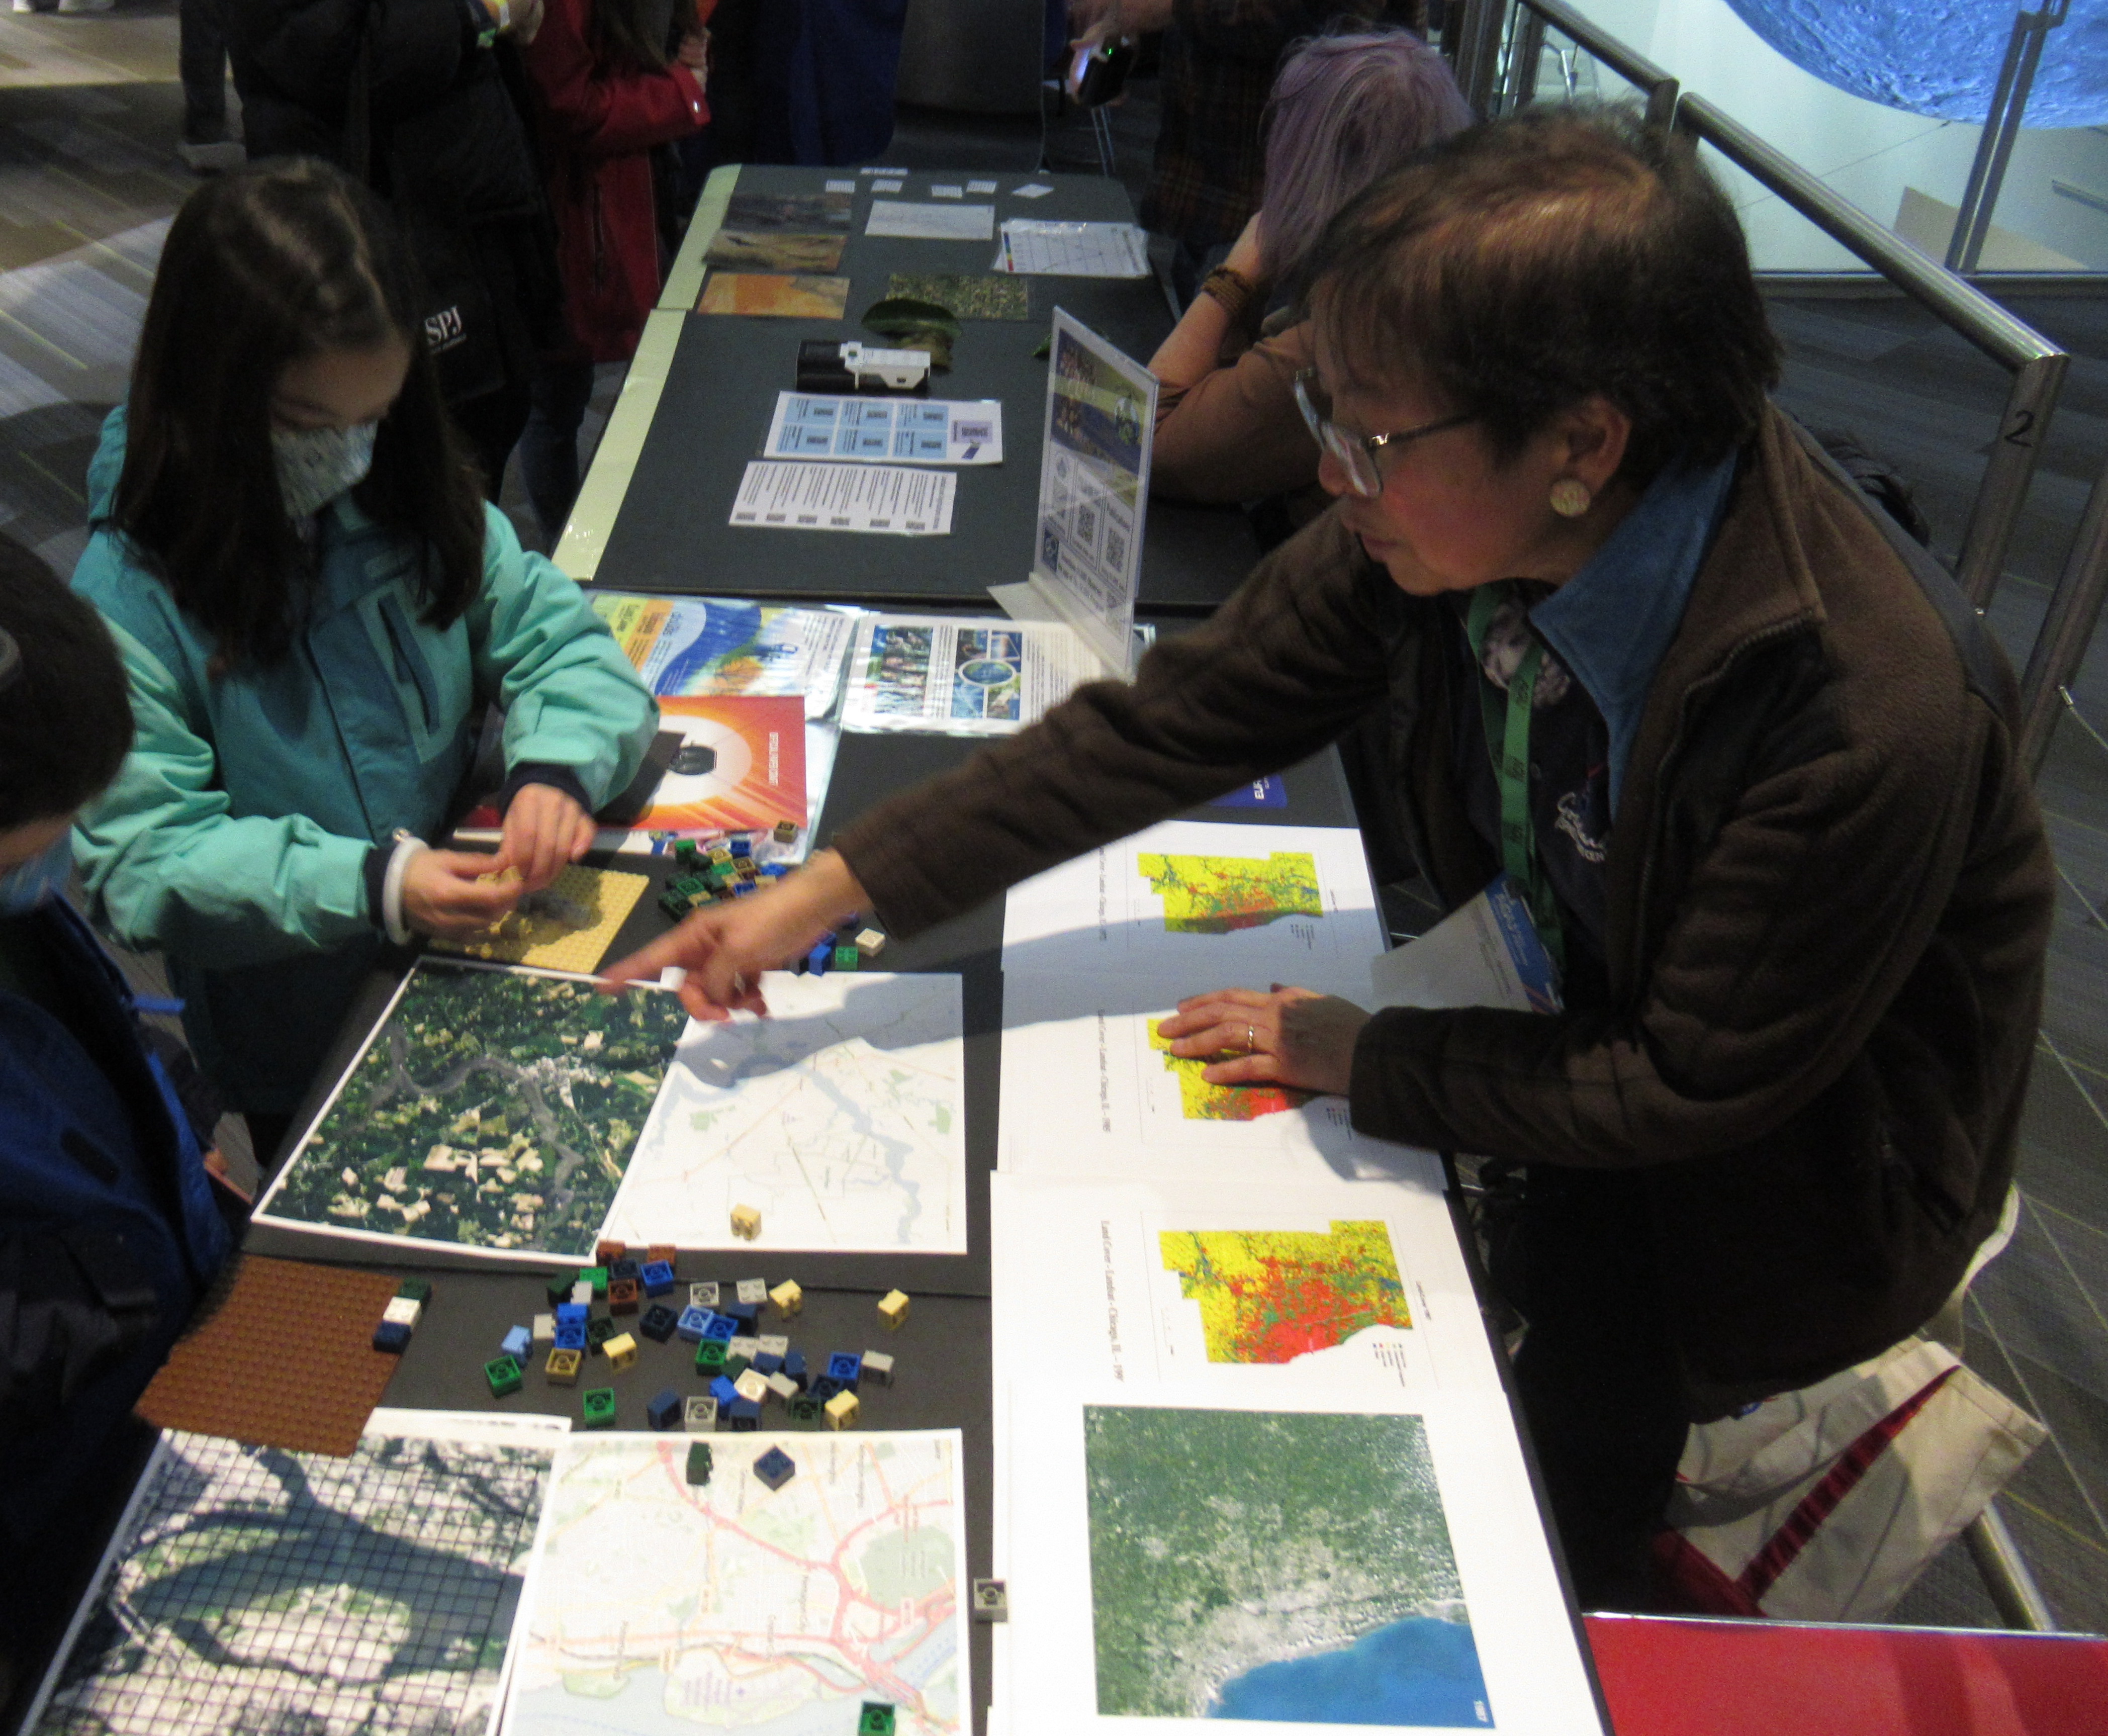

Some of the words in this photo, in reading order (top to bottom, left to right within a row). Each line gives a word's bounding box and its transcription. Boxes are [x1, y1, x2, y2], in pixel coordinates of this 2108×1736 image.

[2004, 410, 2035, 447] 2
[1101, 1220, 1112, 1240] Land
[1103, 1240, 1113, 1264] Cover
